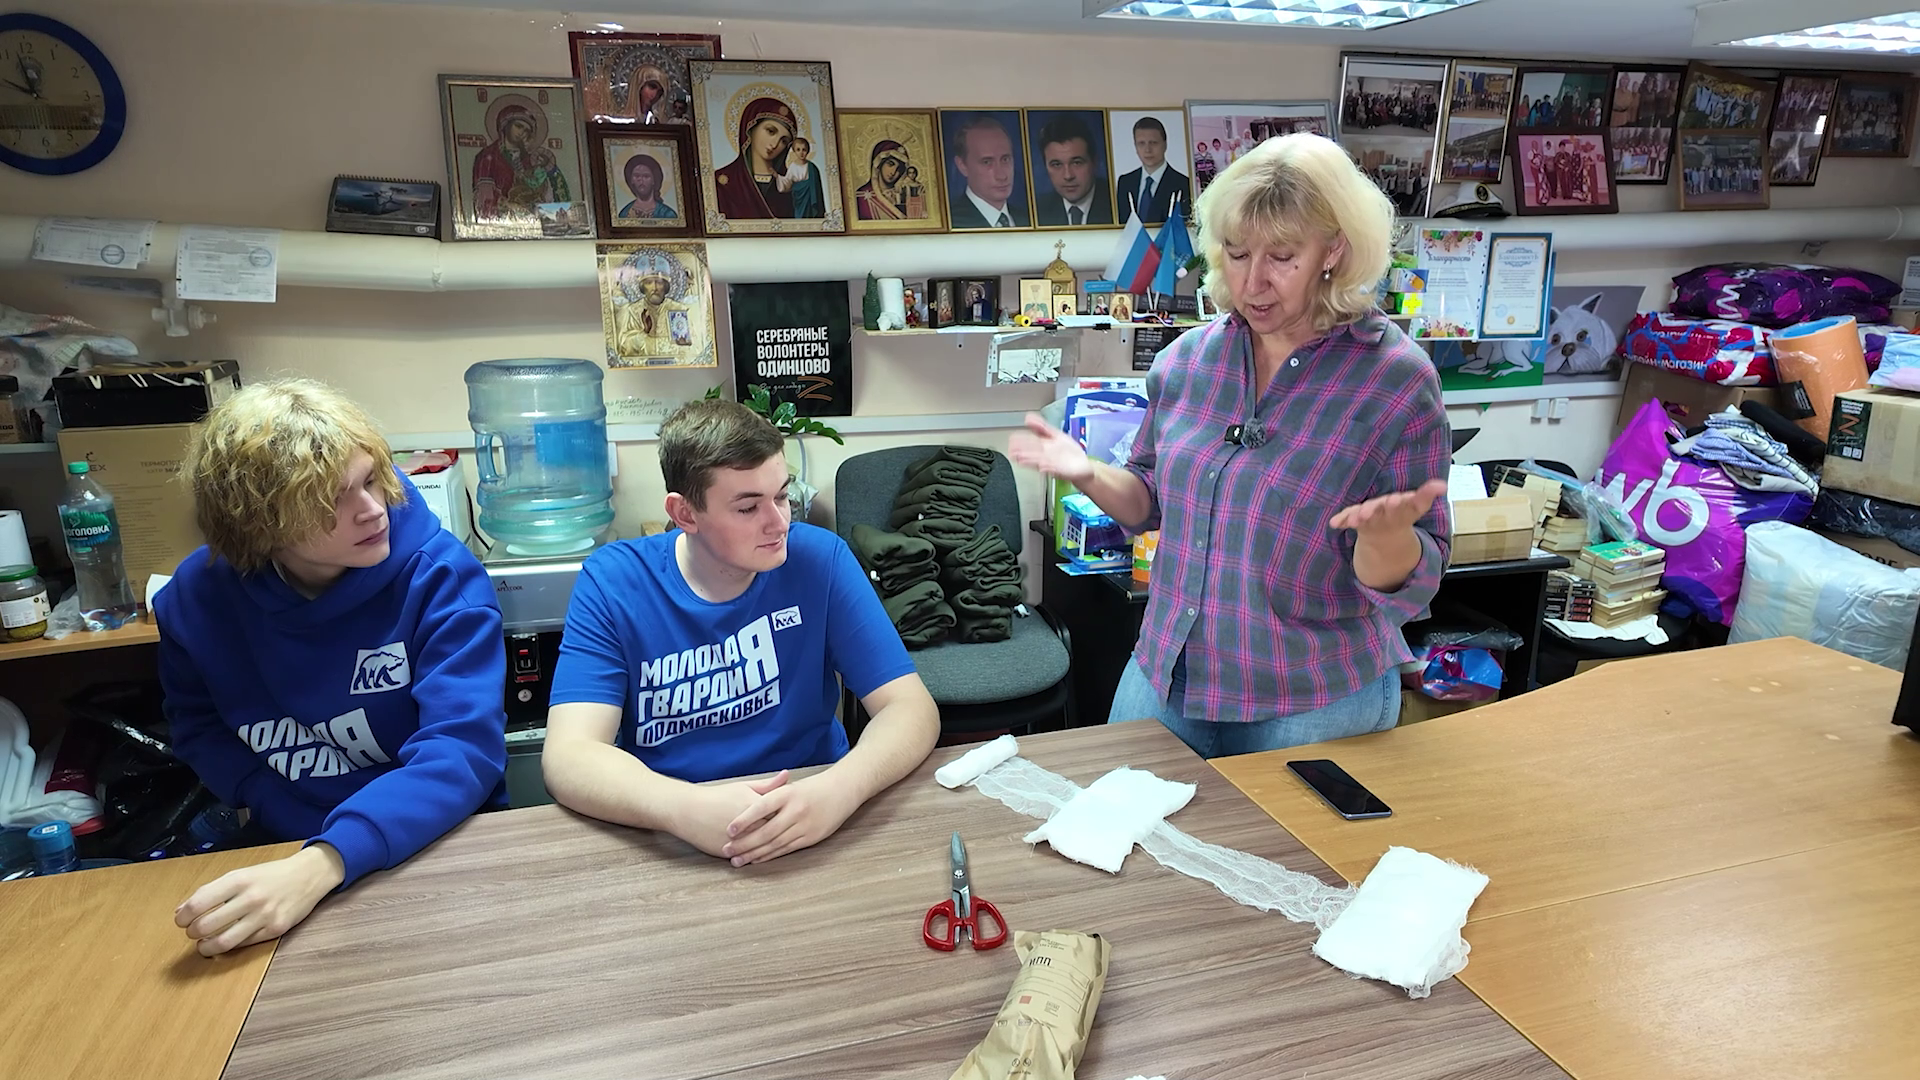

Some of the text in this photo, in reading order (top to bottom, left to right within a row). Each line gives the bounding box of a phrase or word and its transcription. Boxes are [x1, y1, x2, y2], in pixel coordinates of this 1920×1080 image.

[19, 42, 34, 54] 12
[49, 48, 56, 61] 1
[70, 66, 80, 79] 2
[82, 90, 91, 102] 3
[41, 136, 51, 147] 6
[66, 130, 74, 141] 5
[756, 326, 828, 344] СЕРЕБРЯНЫЕ
[757, 342, 829, 360] ВОЛОНТЕРЫ
[757, 358, 831, 378] ОДИНЦОВО
[640, 615, 780, 692] МОЛОДАЯ
[642, 684, 774, 745] ПОДМОСКОВЬЕ
